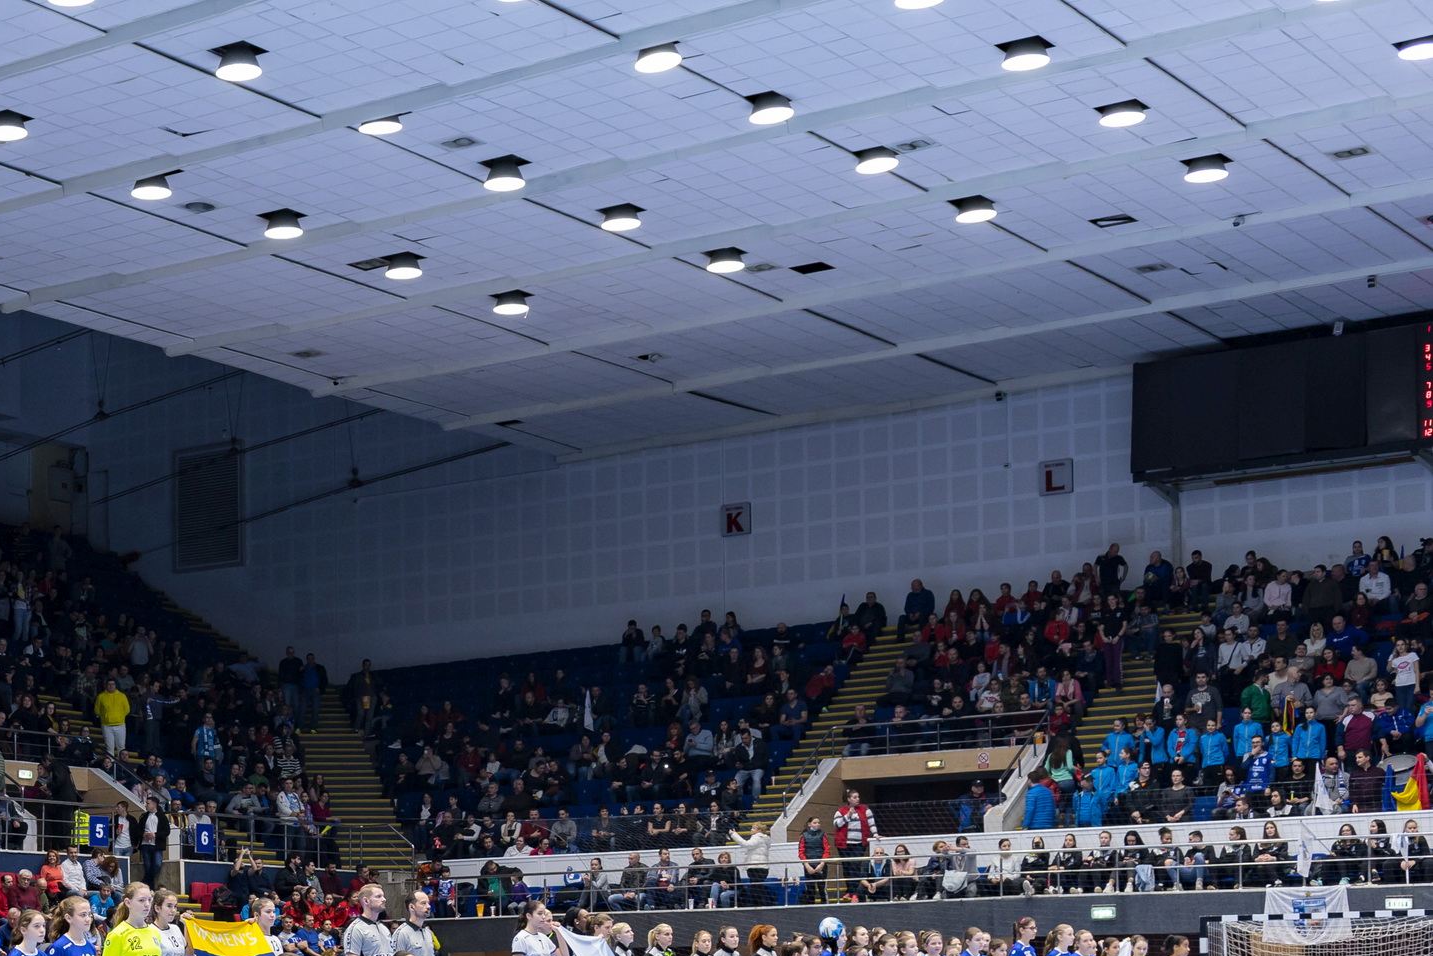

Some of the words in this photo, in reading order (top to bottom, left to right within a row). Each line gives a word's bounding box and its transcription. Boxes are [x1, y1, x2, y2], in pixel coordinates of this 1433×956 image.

[1425, 344, 1431, 352] 3
[1426, 391, 1432, 399] 8
[1045, 470, 1065, 492] L
[726, 512, 744, 534] K
[95, 823, 104, 839] 5
[200, 830, 209, 845] 6
[195, 923, 257, 947] WOMEN'S
[127, 936, 142, 951] 12
